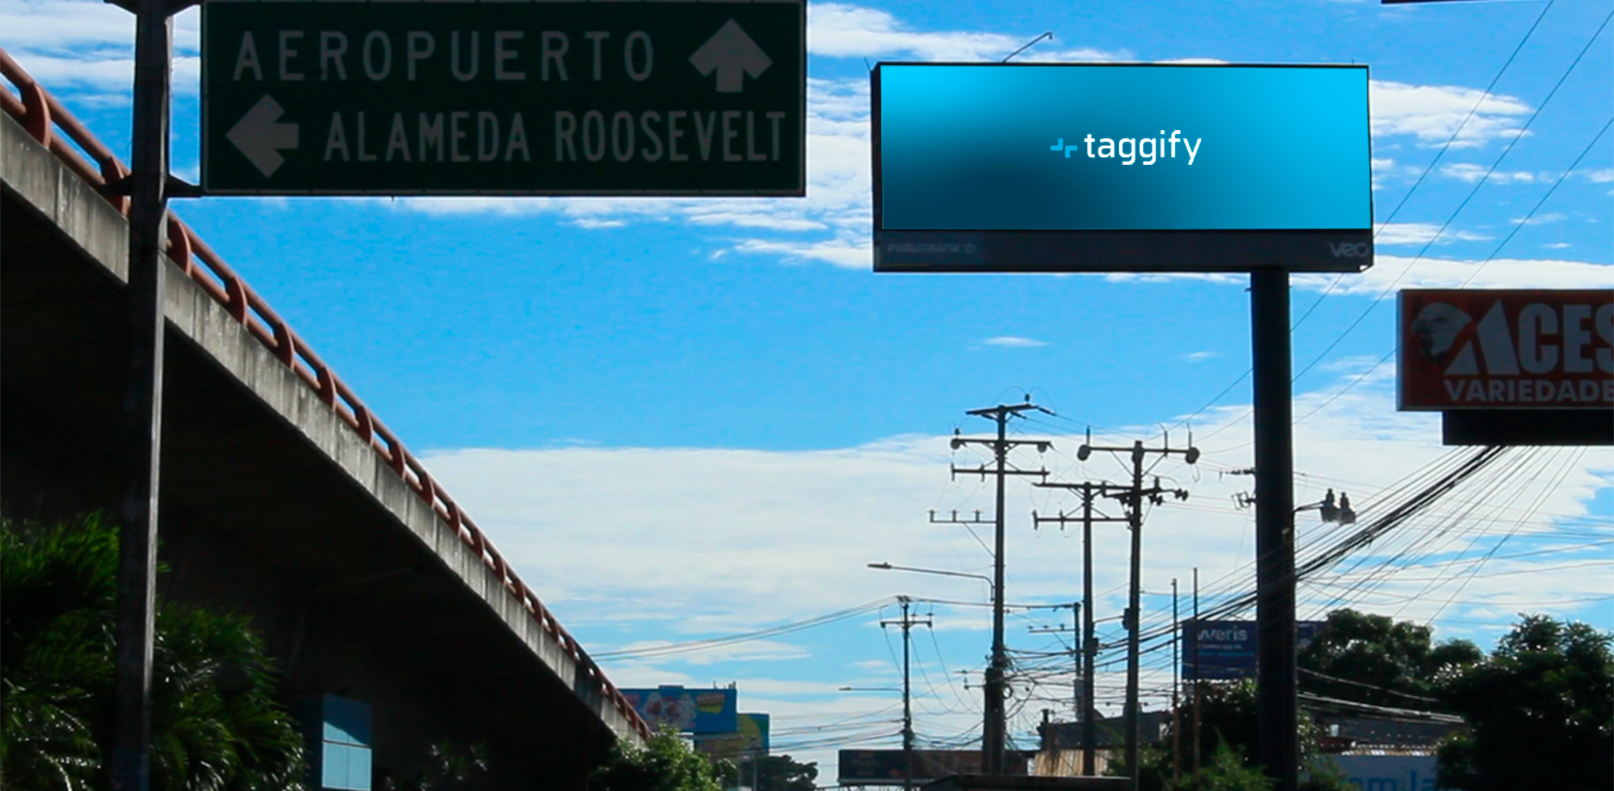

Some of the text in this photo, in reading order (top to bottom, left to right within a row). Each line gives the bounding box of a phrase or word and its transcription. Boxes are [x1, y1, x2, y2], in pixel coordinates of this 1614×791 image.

[233, 30, 654, 82] AEROPUERTO
[324, 110, 786, 162] ALAMEDA ROOSEVELT
[1084, 130, 1203, 165] taggify
